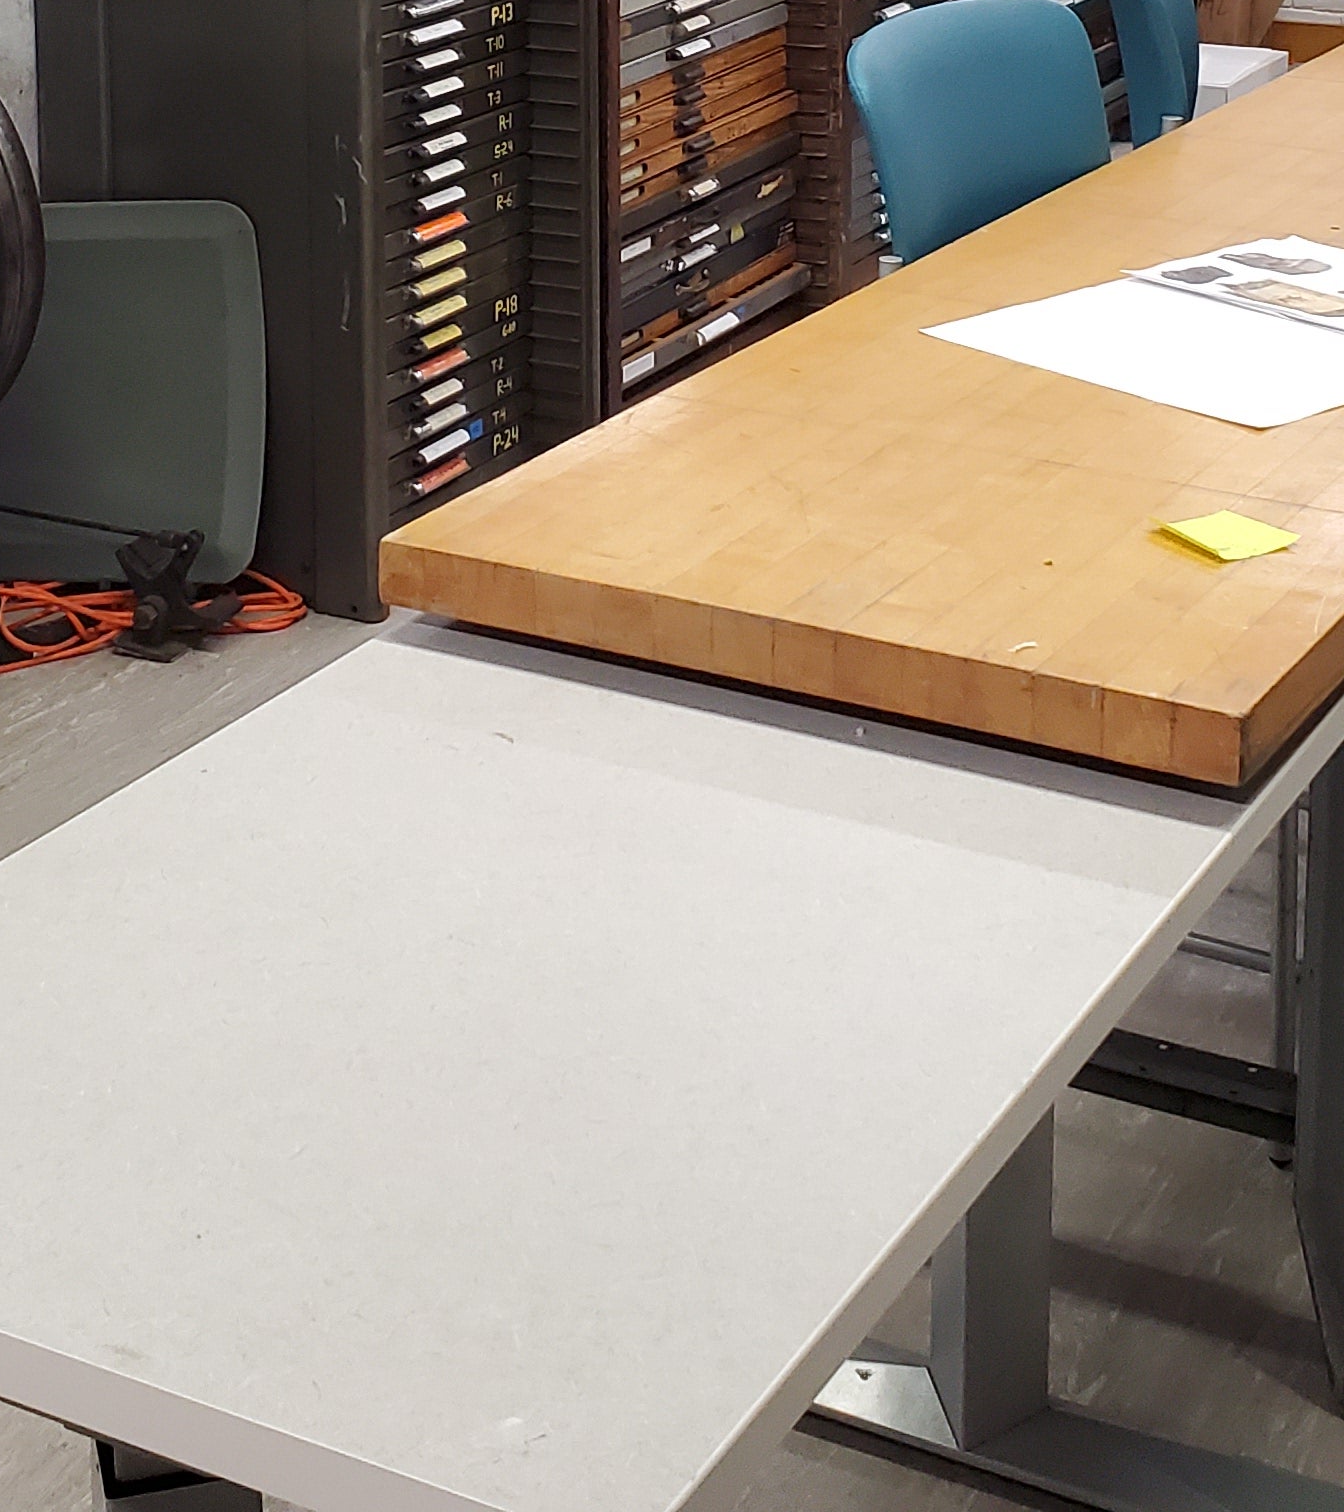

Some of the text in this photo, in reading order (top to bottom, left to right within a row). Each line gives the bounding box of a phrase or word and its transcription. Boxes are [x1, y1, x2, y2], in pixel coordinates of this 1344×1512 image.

[491, 2, 513, 26] P-13
[495, 294, 518, 323] P-18
[493, 428, 519, 456] P-24
